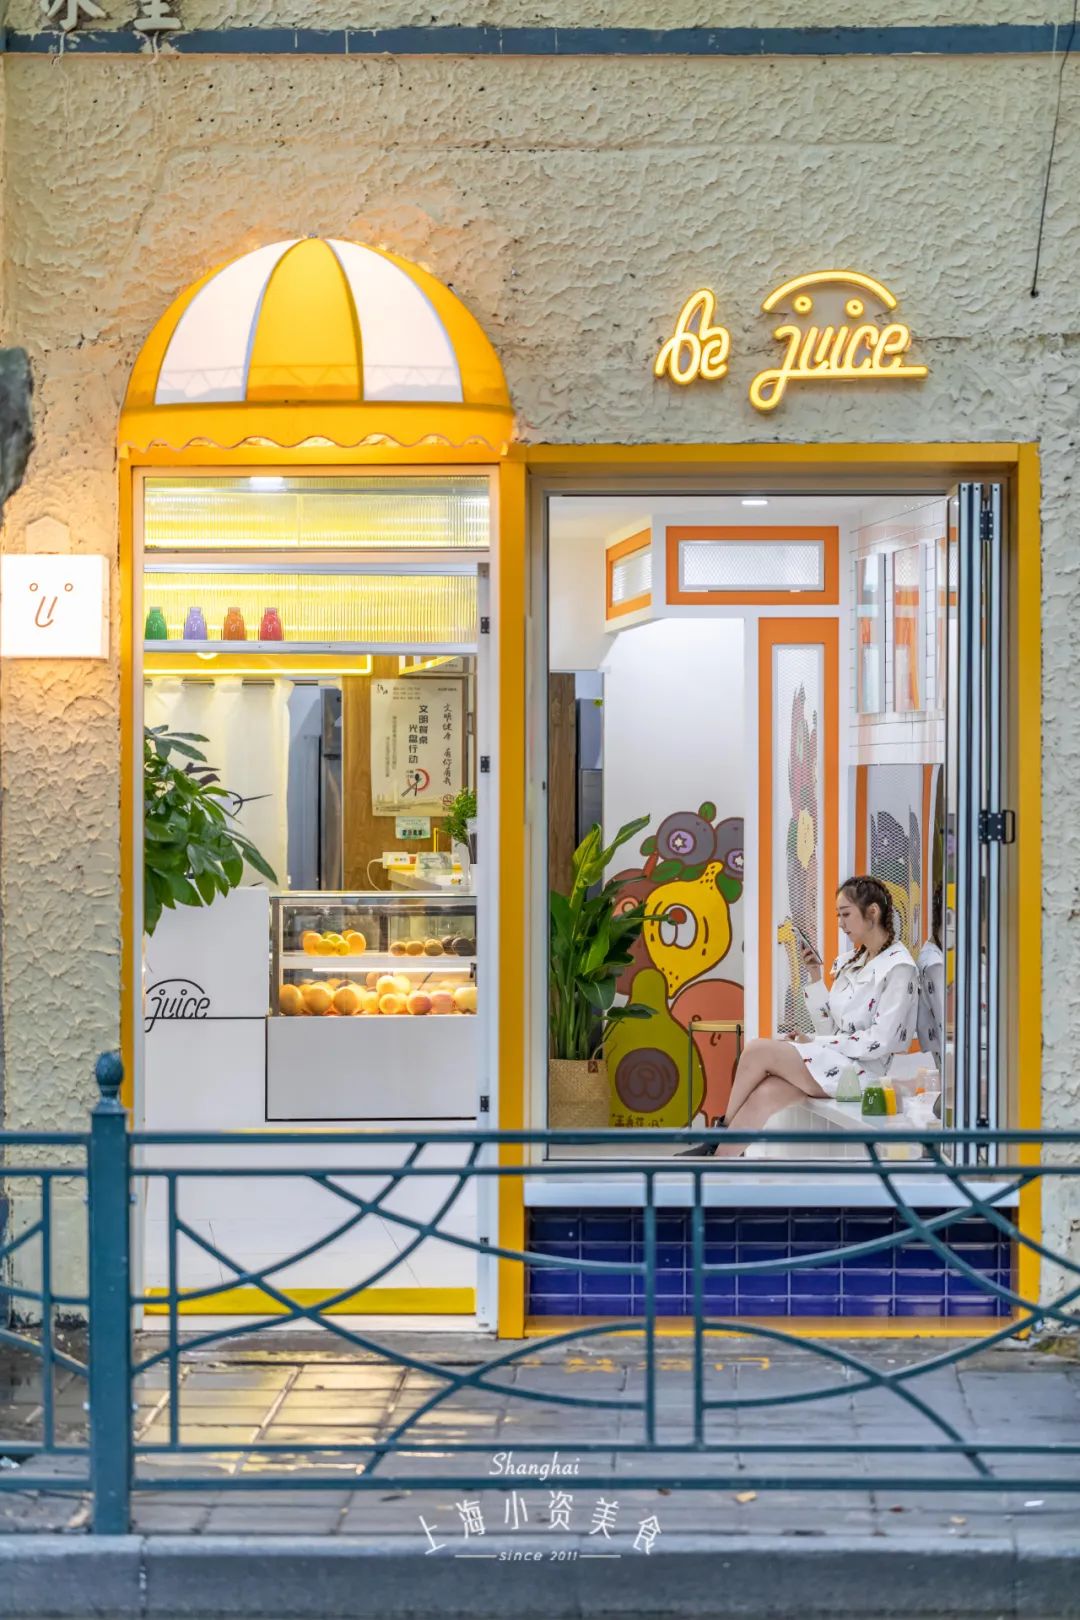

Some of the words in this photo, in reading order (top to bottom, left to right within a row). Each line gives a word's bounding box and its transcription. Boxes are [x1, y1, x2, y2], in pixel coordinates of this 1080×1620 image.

[653, 287, 731, 385] be
[750, 294, 929, 411] juice
[408, 723, 419, 764] 光盘行动
[144, 988, 211, 1034] juice
